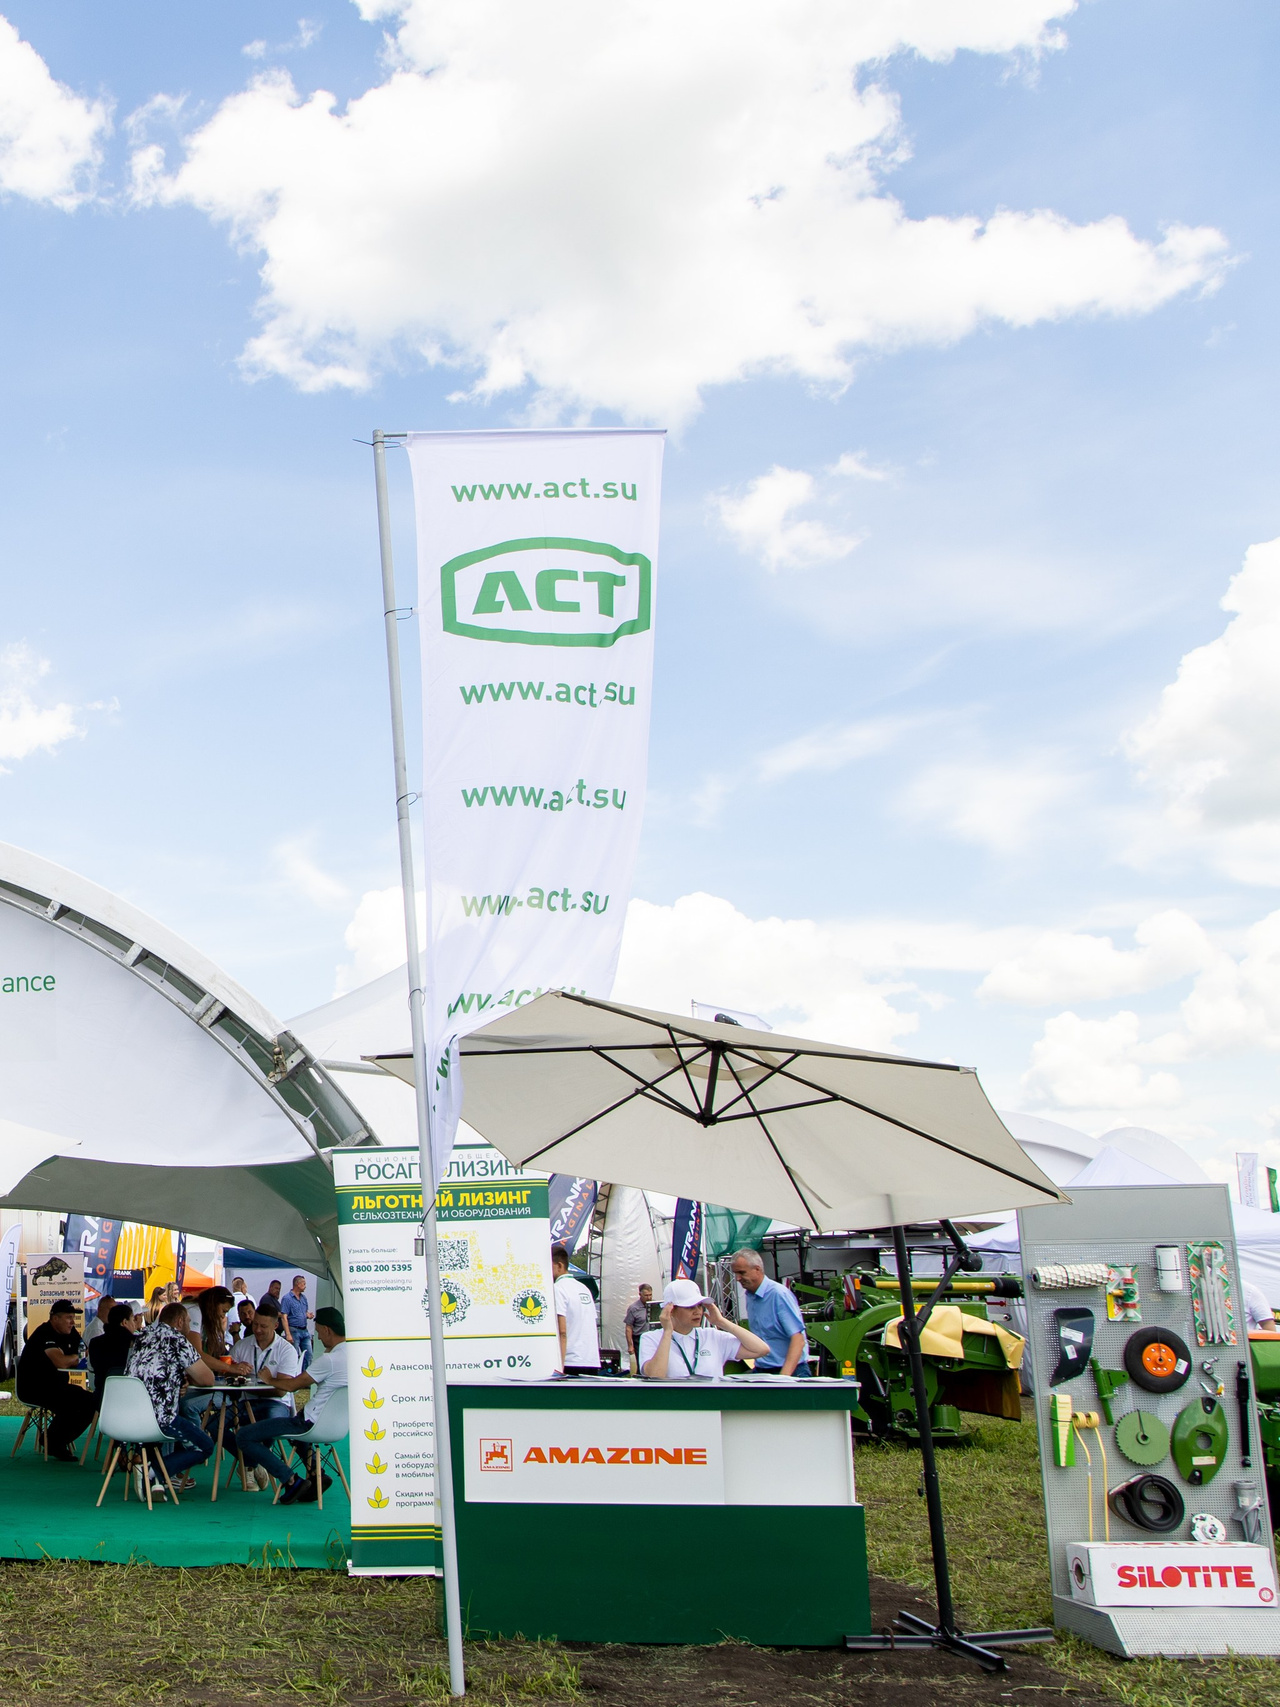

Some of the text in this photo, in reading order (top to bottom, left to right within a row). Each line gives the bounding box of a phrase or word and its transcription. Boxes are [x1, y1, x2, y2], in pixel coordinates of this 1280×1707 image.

[451, 478, 637, 502] www.act.su
[472, 569, 626, 618] ACT
[459, 681, 636, 707] www.actsu
[461, 778, 626, 812] www.at.su
[359, 1152, 499, 1163] АКЦИОНЕ ОБЩЕС
[351, 1190, 532, 1210] ЛЬГОТНЙ ЛИЗИНГ
[451, 1207, 532, 1218] ОБОРУДОВАНИЯ
[348, 1263, 412, 1273] 8 800 200 5395
[445, 1362, 481, 1370] платеж
[483, 1359, 502, 1369] от
[507, 1355, 532, 1368] 0%
[391, 1394, 417, 1404] Срок
[392, 1420, 434, 1430] Приобрете
[392, 1430, 434, 1439] российско
[394, 1451, 421, 1460] Самый
[523, 1446, 708, 1465] AMAZONE
[401, 1461, 434, 1470] оборудо
[401, 1471, 434, 1479] мобильн
[395, 1490, 424, 1498] Скидки
[395, 1501, 434, 1509] программ
